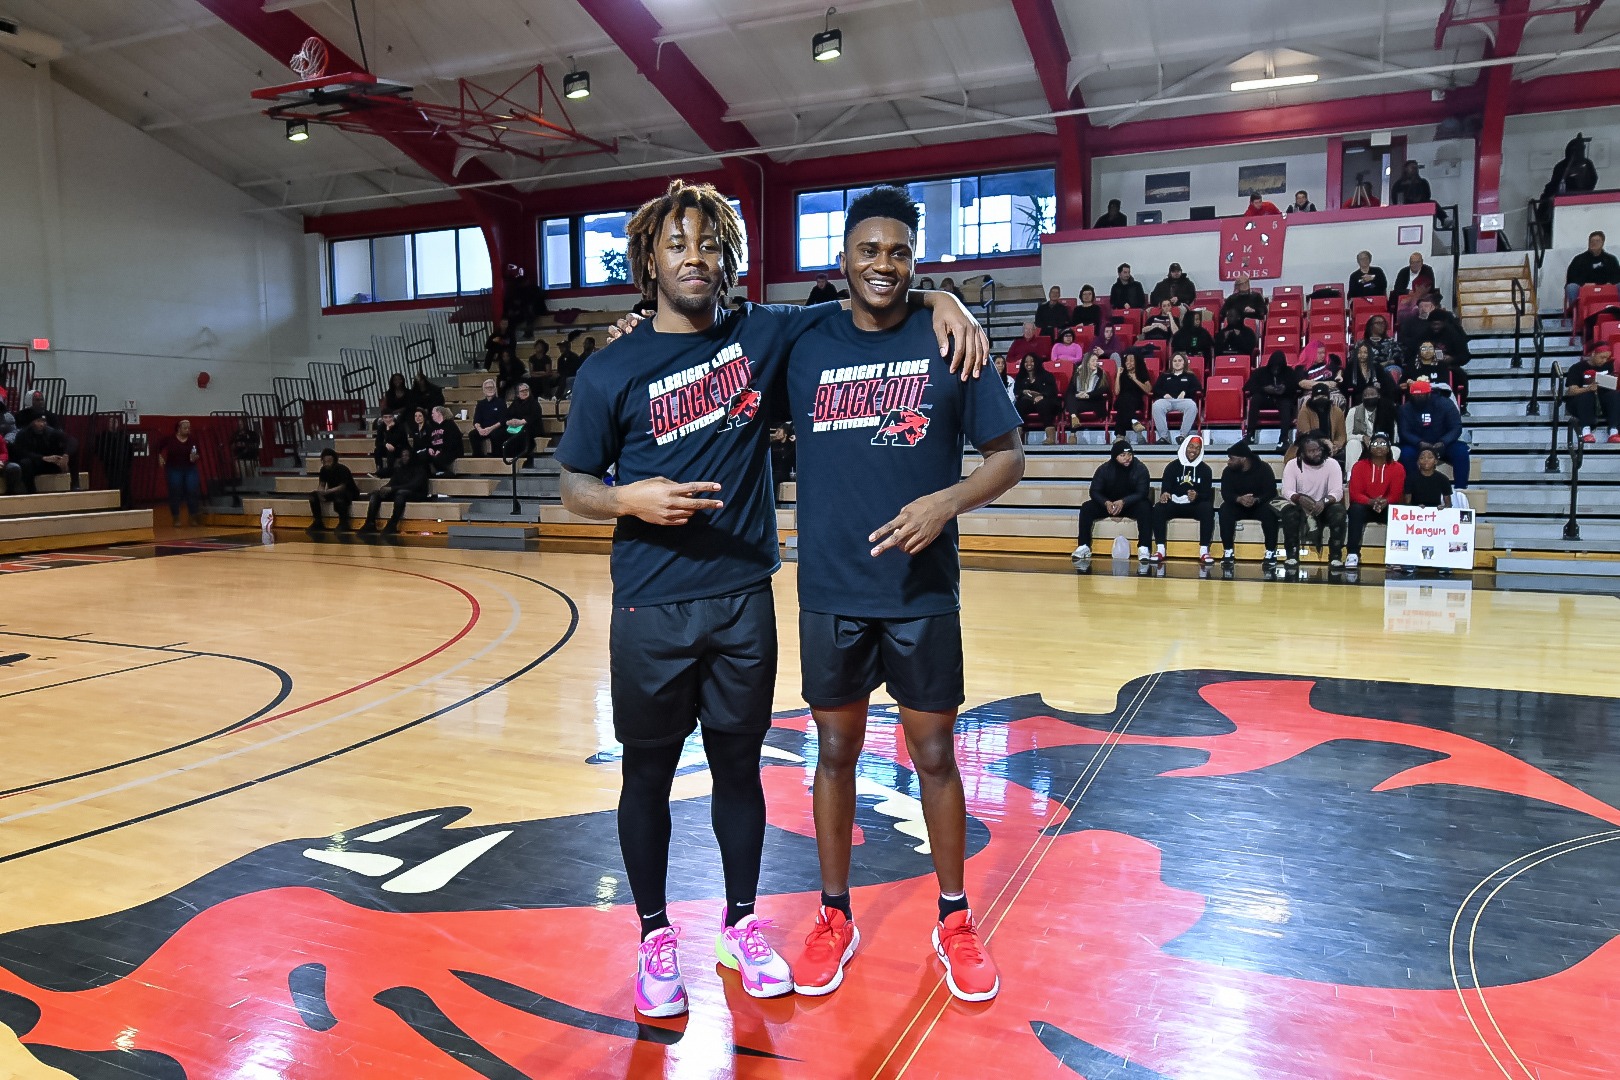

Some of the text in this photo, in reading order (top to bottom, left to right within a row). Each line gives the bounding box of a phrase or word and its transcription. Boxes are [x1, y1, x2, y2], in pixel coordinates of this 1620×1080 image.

[1226, 269, 1268, 279] JONES
[648, 342, 743, 399] ALBRIGHT LIONS
[819, 358, 931, 385] ALBRIGHT LIONS
[650, 372, 719, 438] BLACK
[813, 374, 930, 422] BLACK OUT
[1391, 507, 1437, 522] Robert
[1405, 523, 1446, 537] Mangum
